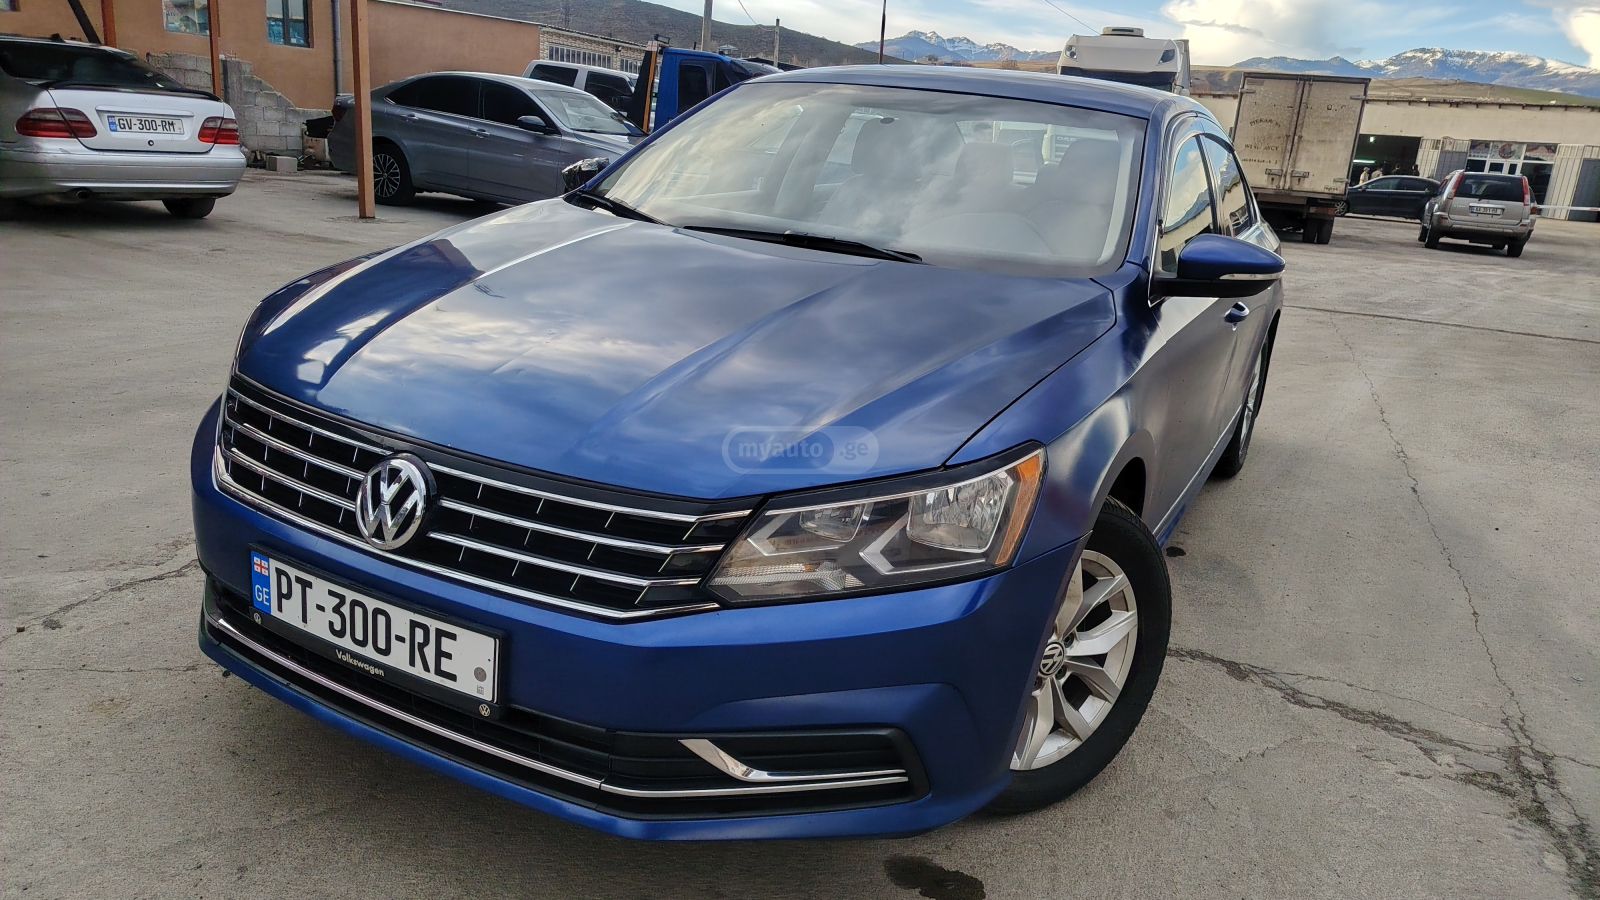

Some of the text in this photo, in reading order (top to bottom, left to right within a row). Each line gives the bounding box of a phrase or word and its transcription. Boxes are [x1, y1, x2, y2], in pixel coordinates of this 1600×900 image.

[117, 117, 176, 132] GV-300-RM
[254, 584, 270, 606] GE
[274, 566, 458, 683] PT-300-RE
[335, 648, 385, 677] Volkswagen
